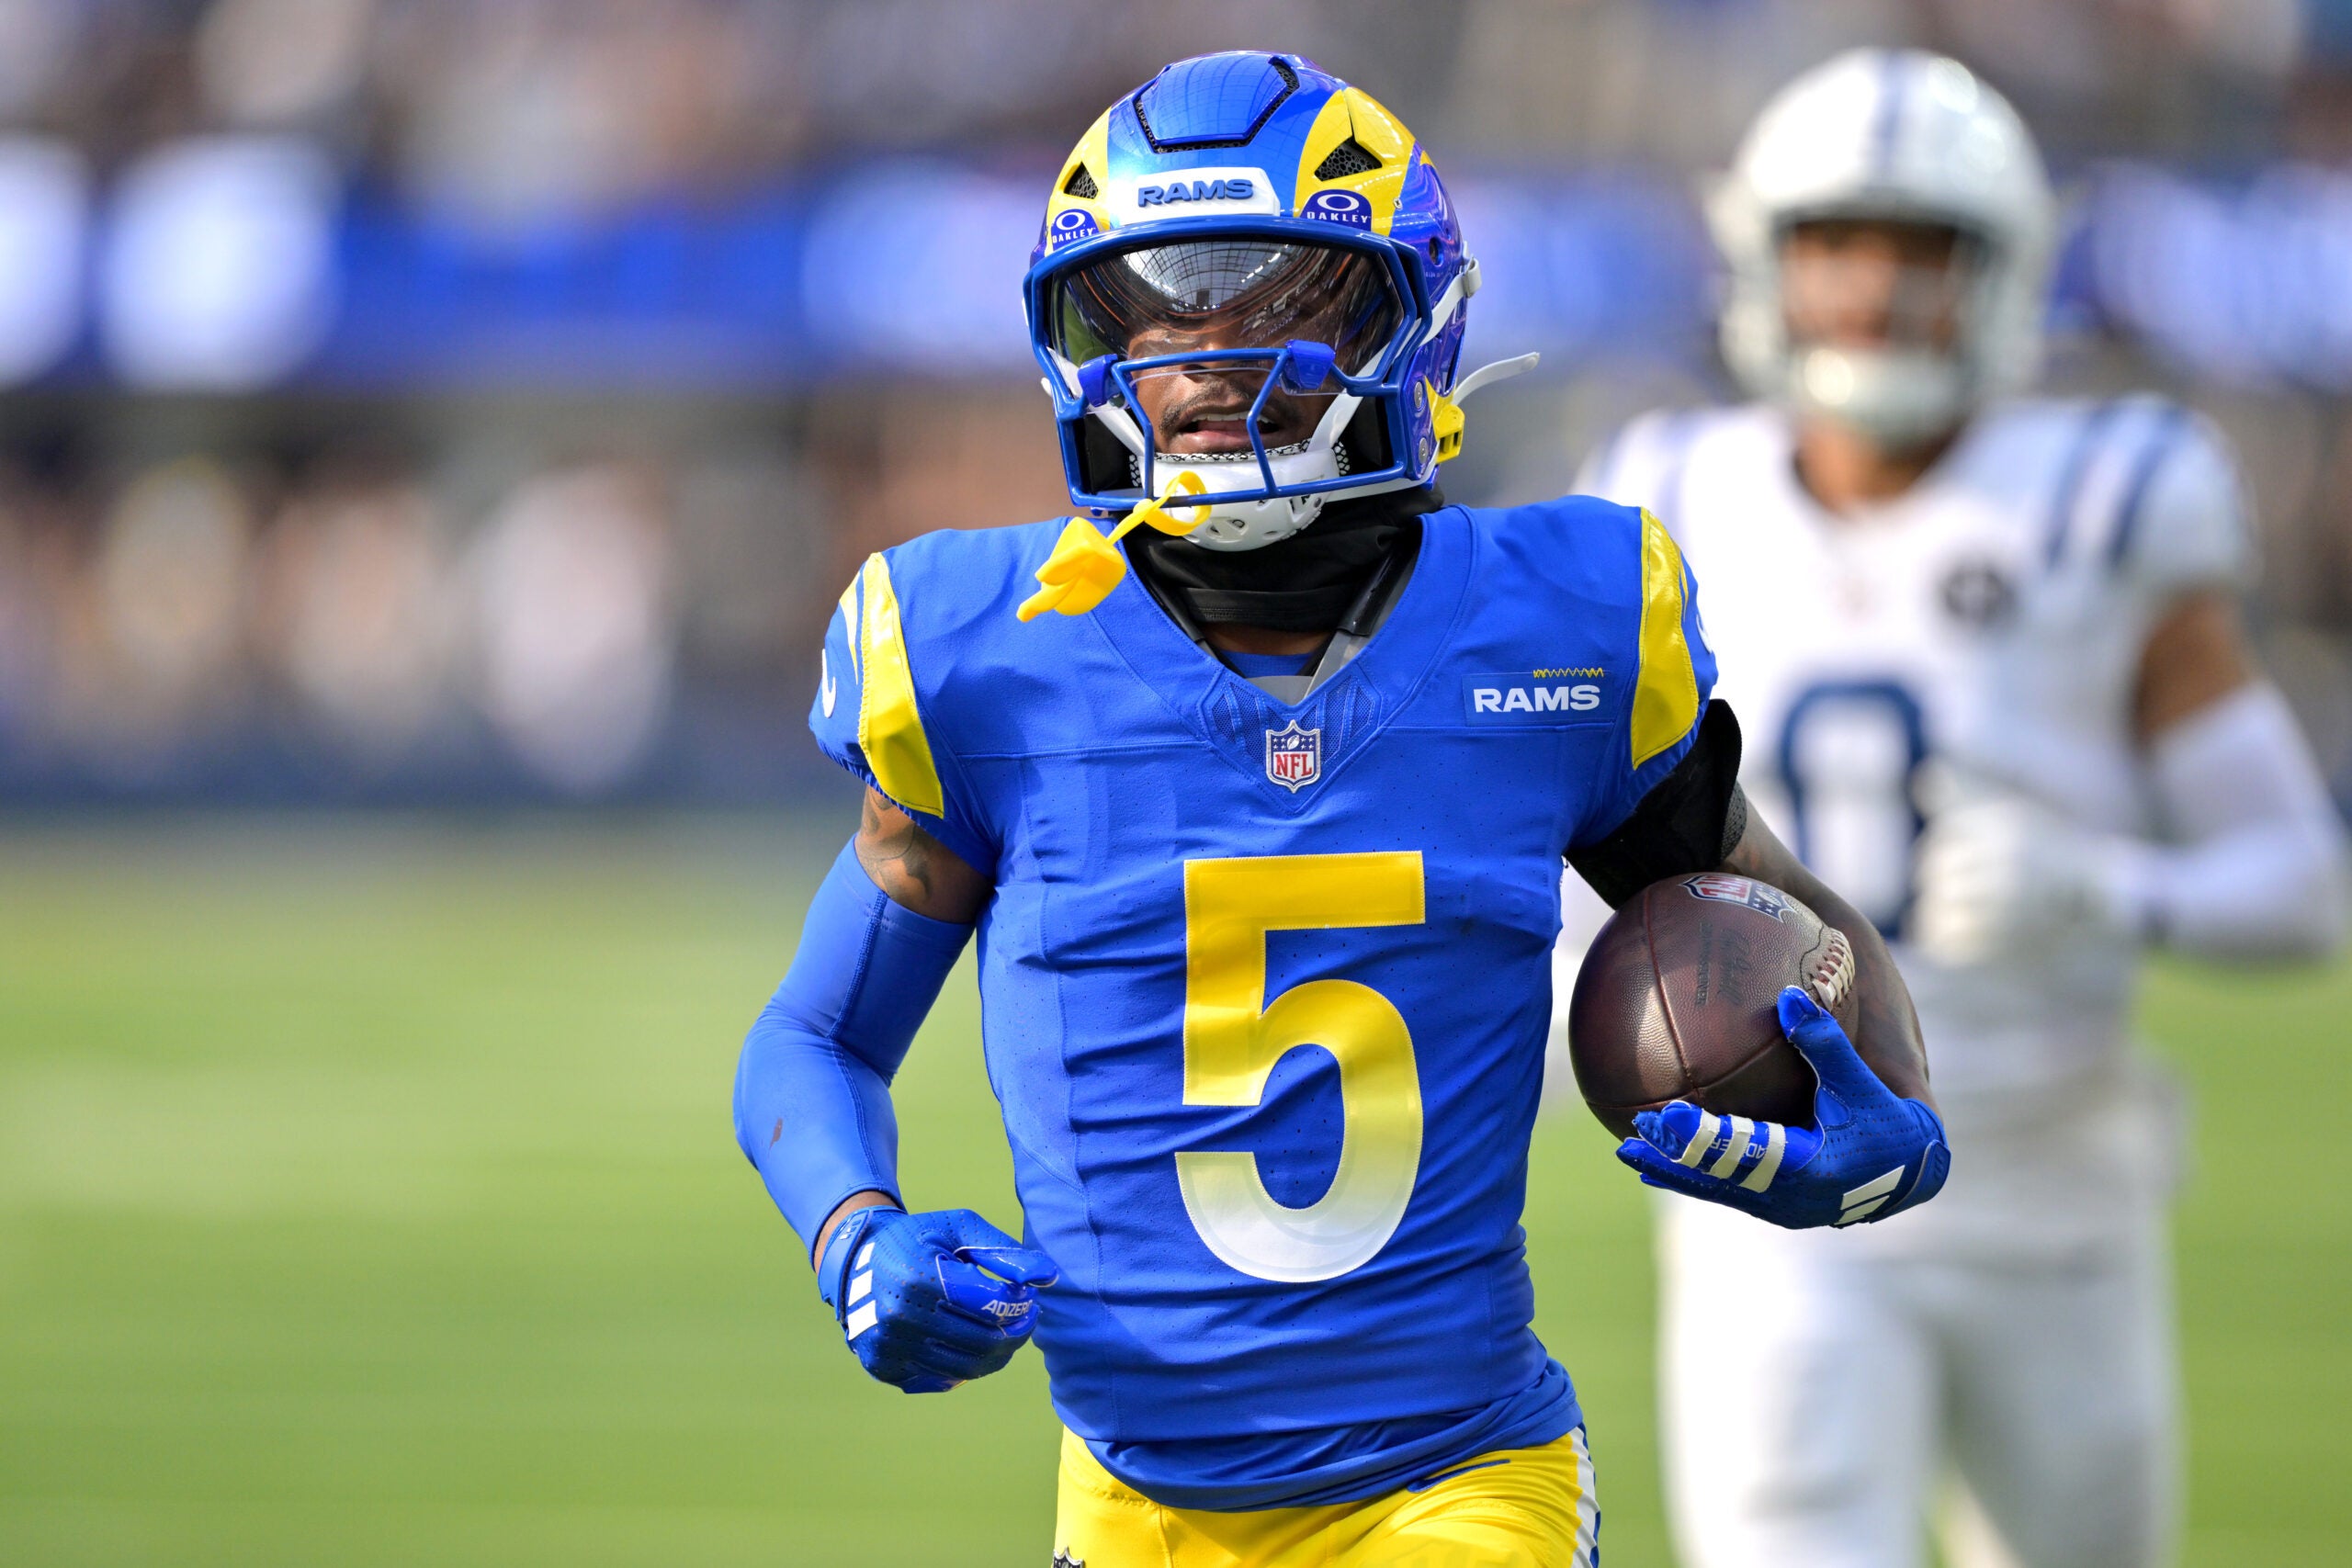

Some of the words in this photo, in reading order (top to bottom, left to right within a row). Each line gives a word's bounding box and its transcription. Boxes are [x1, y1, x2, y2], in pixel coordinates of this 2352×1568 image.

[1138, 179, 1253, 208] RAMS
[1306, 211, 1368, 223] OAKLEY
[1052, 228, 1093, 243] OAKLEY
[1474, 684, 1600, 713] RAMS
[1275, 753, 1313, 780] NFL
[1175, 851, 1426, 1282] 5
